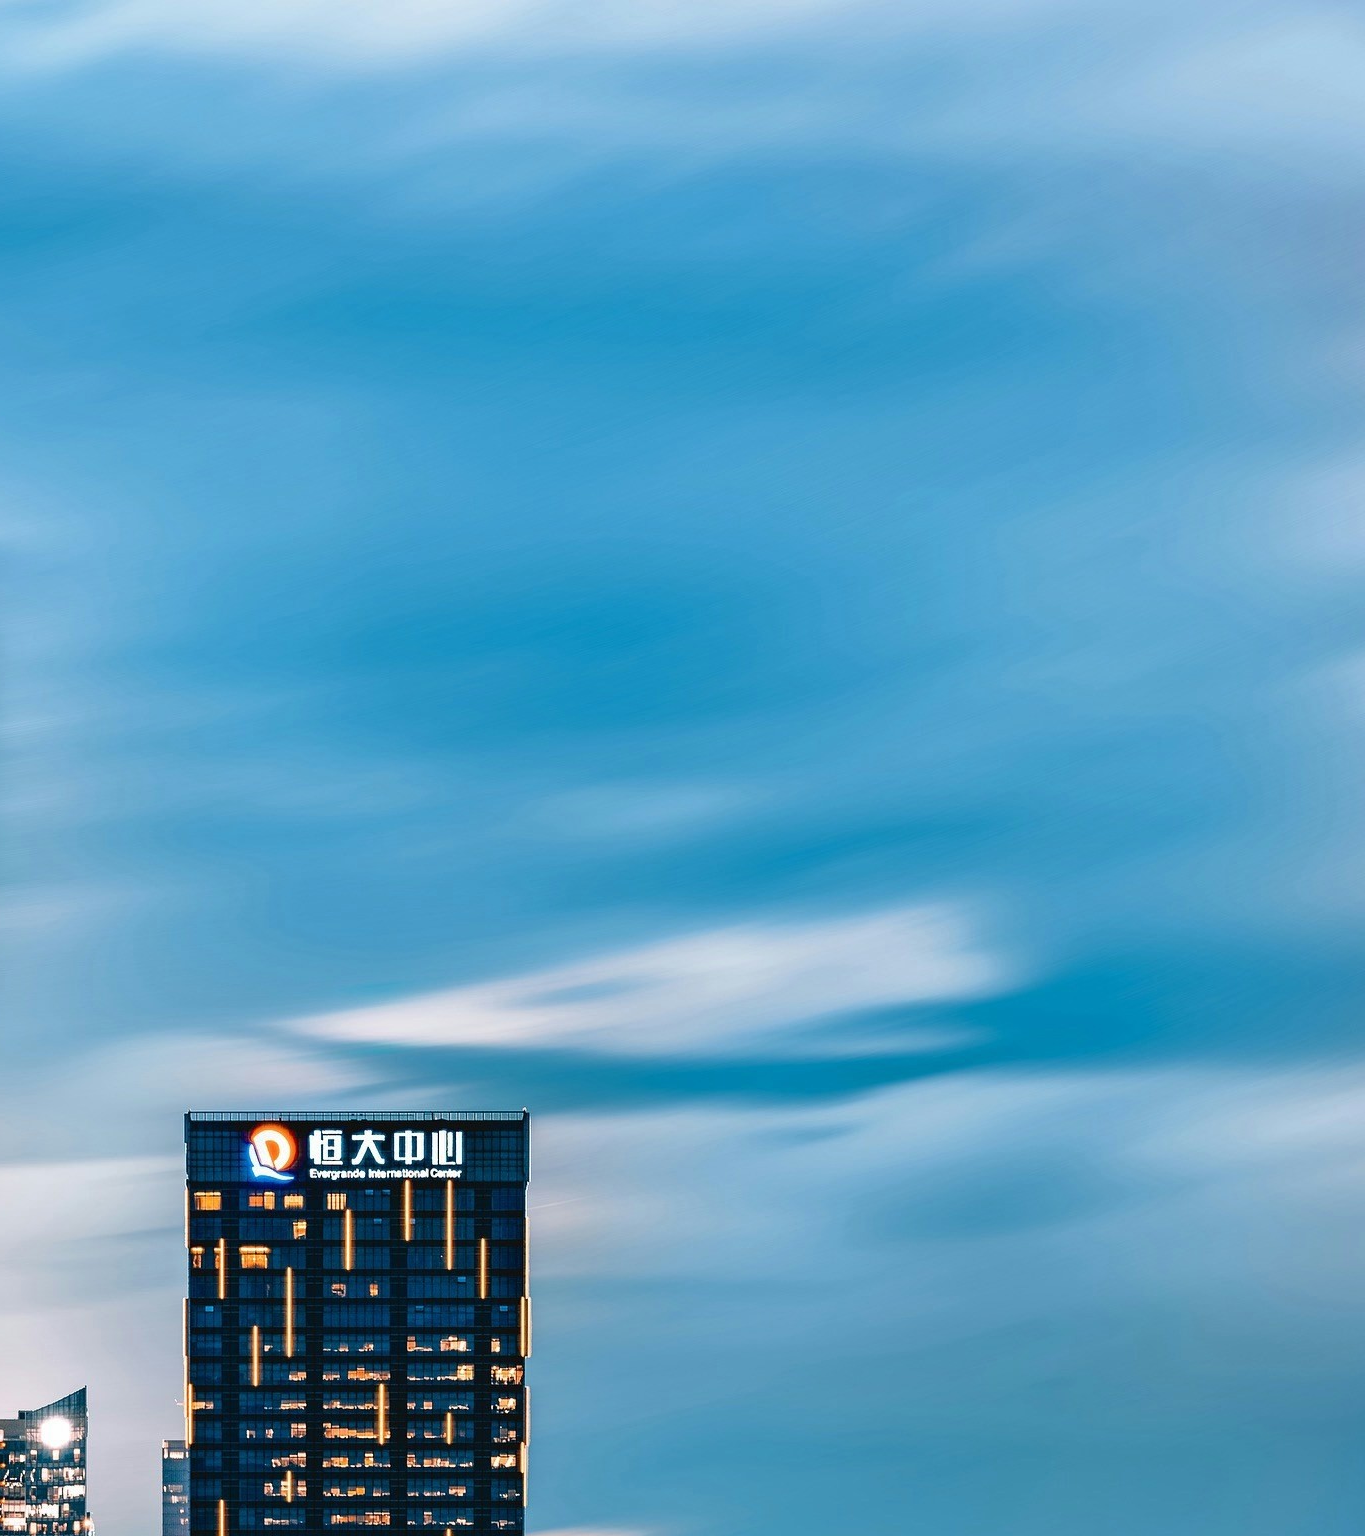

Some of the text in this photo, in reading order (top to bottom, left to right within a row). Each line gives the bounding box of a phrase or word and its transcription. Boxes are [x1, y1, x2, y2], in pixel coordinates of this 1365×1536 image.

[309, 1129, 463, 1166] 恒大中心
[309, 1168, 463, 1181] Evergrande International Center
